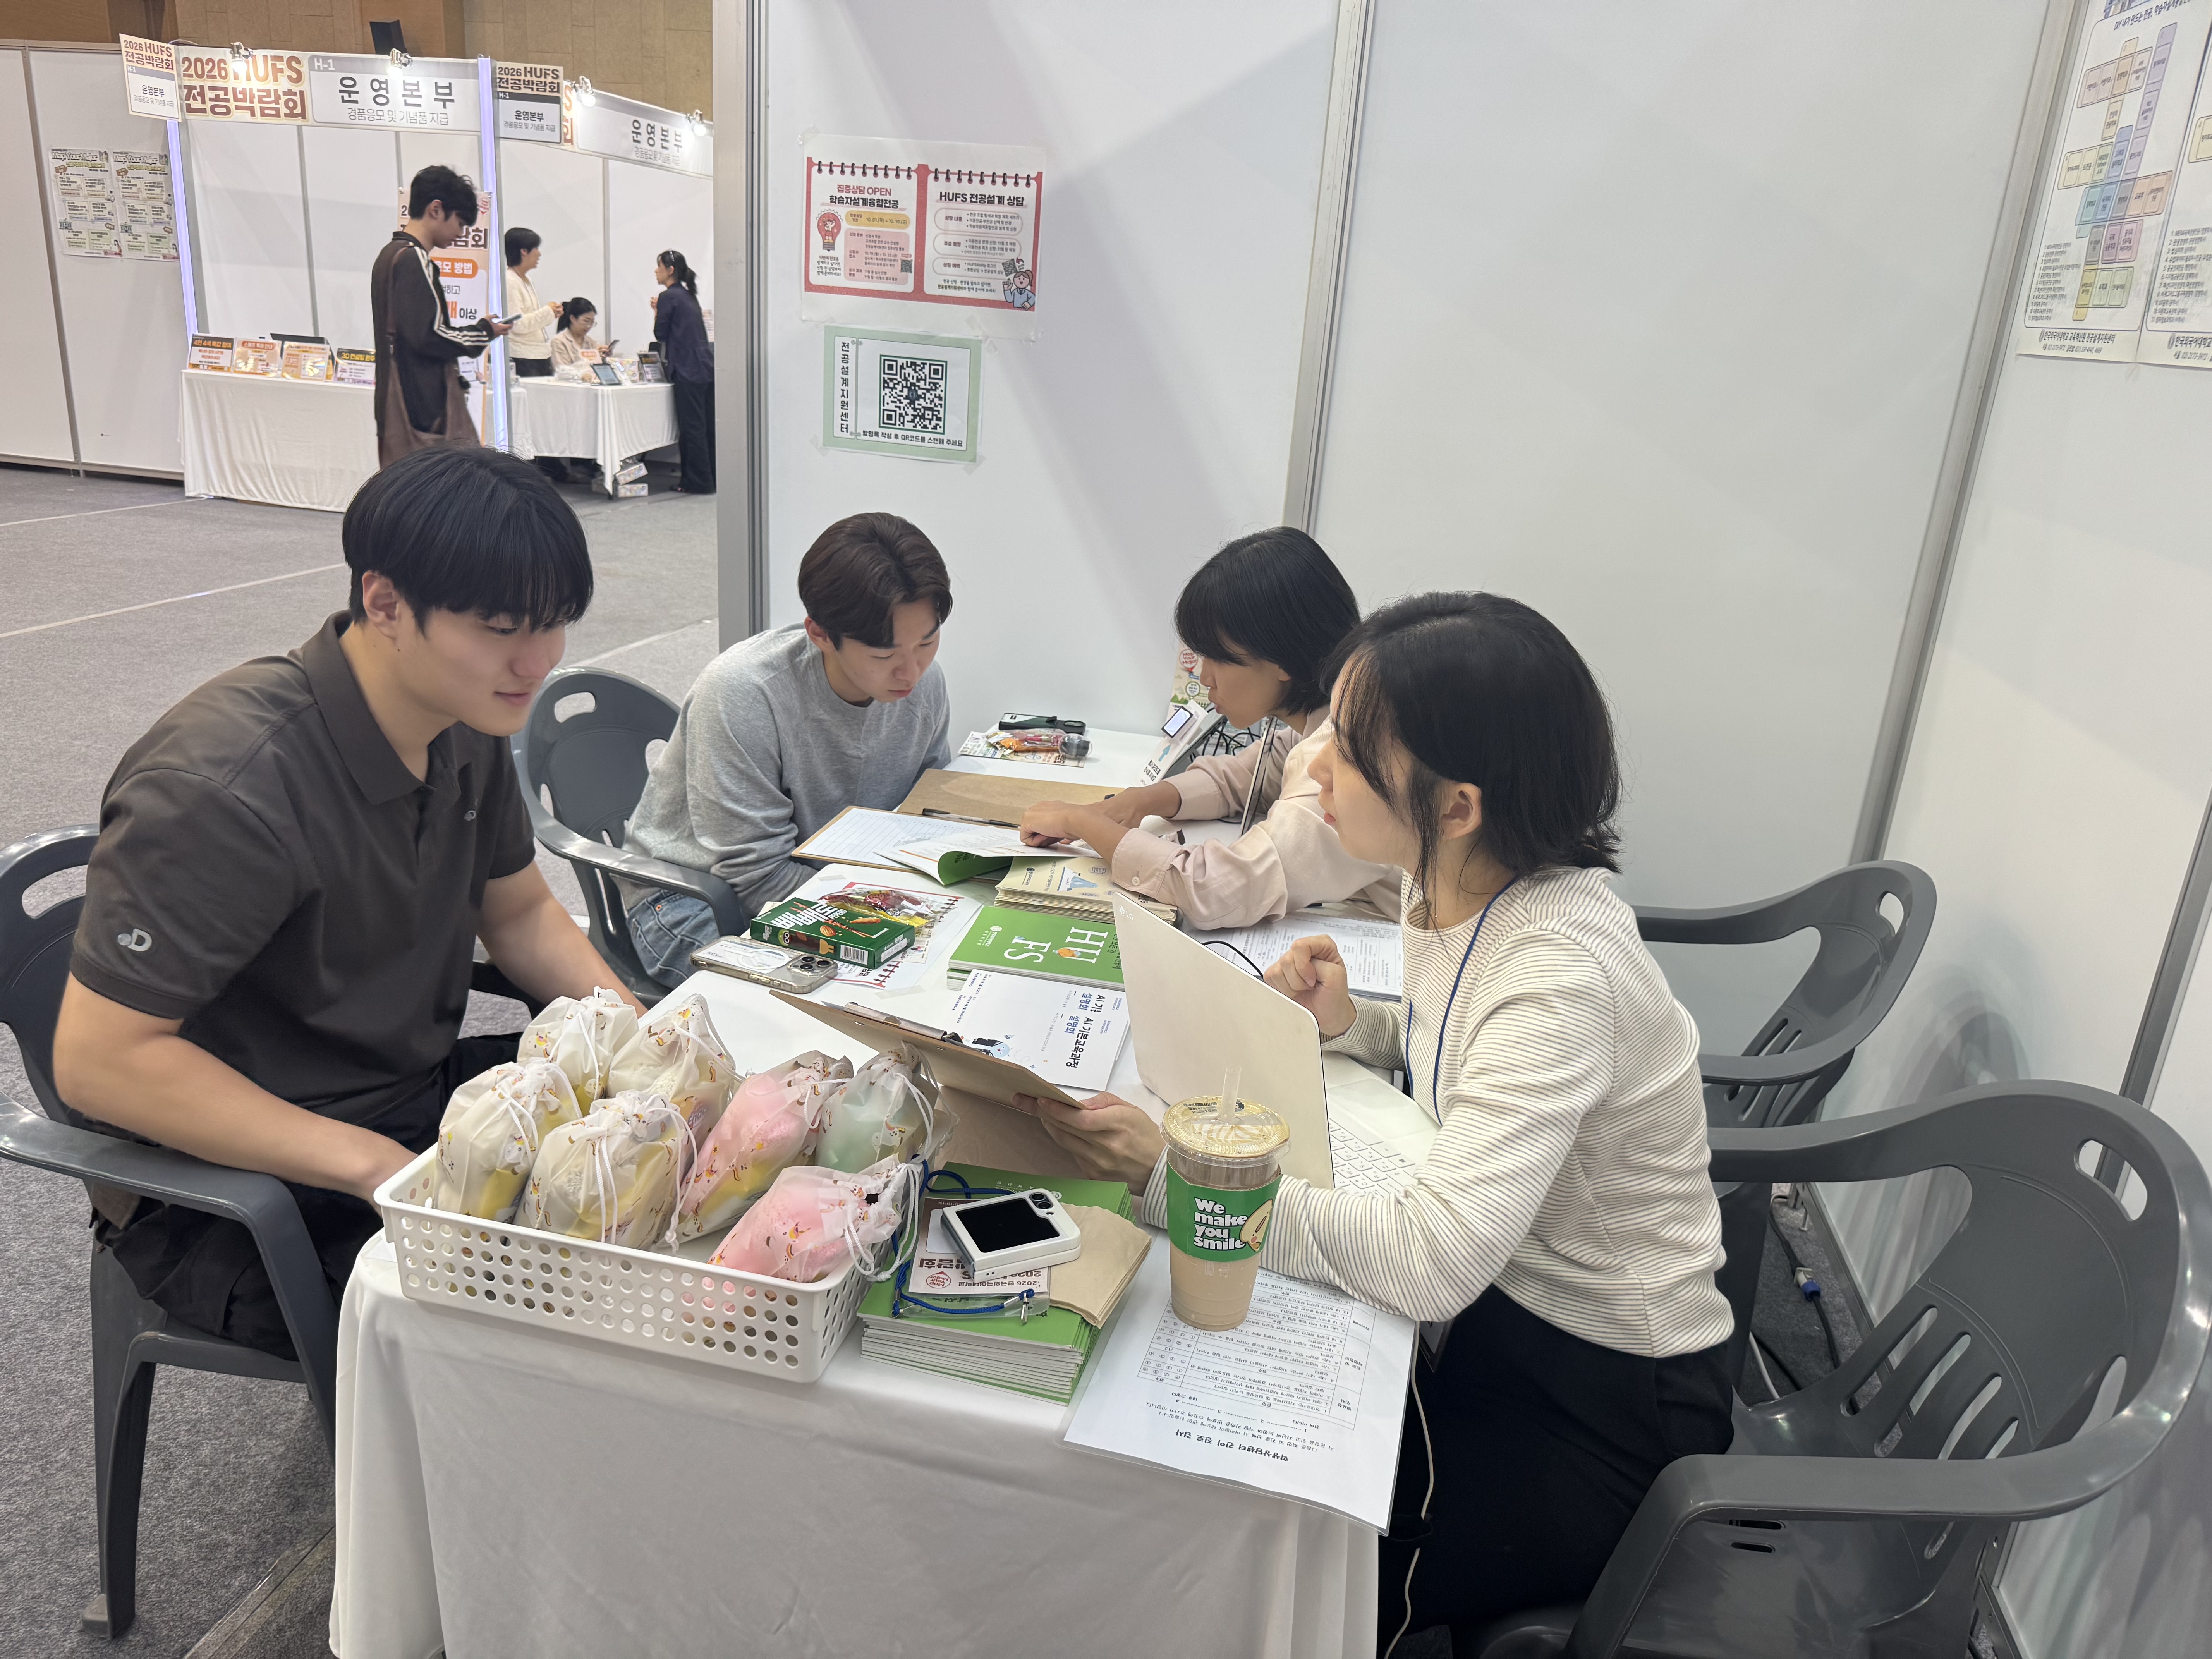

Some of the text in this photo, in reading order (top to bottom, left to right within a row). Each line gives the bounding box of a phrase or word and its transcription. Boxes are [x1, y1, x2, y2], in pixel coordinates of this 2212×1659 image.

[124, 40, 172, 57] 2026 HUFS
[124, 51, 174, 70] 전공박람회
[314, 58, 335, 71] H-1
[182, 57, 228, 81] 2026
[498, 67, 560, 80] 2026 HUFS
[142, 85, 164, 97] 운영본부
[497, 77, 560, 94] 전공박람회
[183, 85, 307, 120] 전공박람회
[348, 108, 448, 125] 경품응모 및 기념품 지급
[515, 110, 544, 122] 운영본부
[837, 184, 891, 196] 집중상담 OPEN
[830, 195, 899, 209] 학습자설계융합전공
[940, 192, 1024, 206] HUFS 전공설계 상담
[459, 308, 477, 320] 이상
[901, 434, 925, 443] QR코드를
[828, 909, 848, 920] PEPERO
[1125, 911, 1133, 920] LG
[1004, 936, 1052, 963] FS
[1077, 993, 1093, 1010] 설명회
[1064, 1015, 1080, 1034] 설명회
[1066, 1026, 1091, 1068] 기본교육과정
[1195, 1197, 1225, 1214] We
[1195, 1212, 1247, 1226] make
[1194, 1224, 1229, 1239] you
[1194, 1237, 1245, 1250] smile
[1225, 1420, 1242, 1428] 가까운
[1276, 1432, 1292, 1440] 자신의
[1175, 1429, 1288, 1462] 학생상담센터 간이 진로 검사
